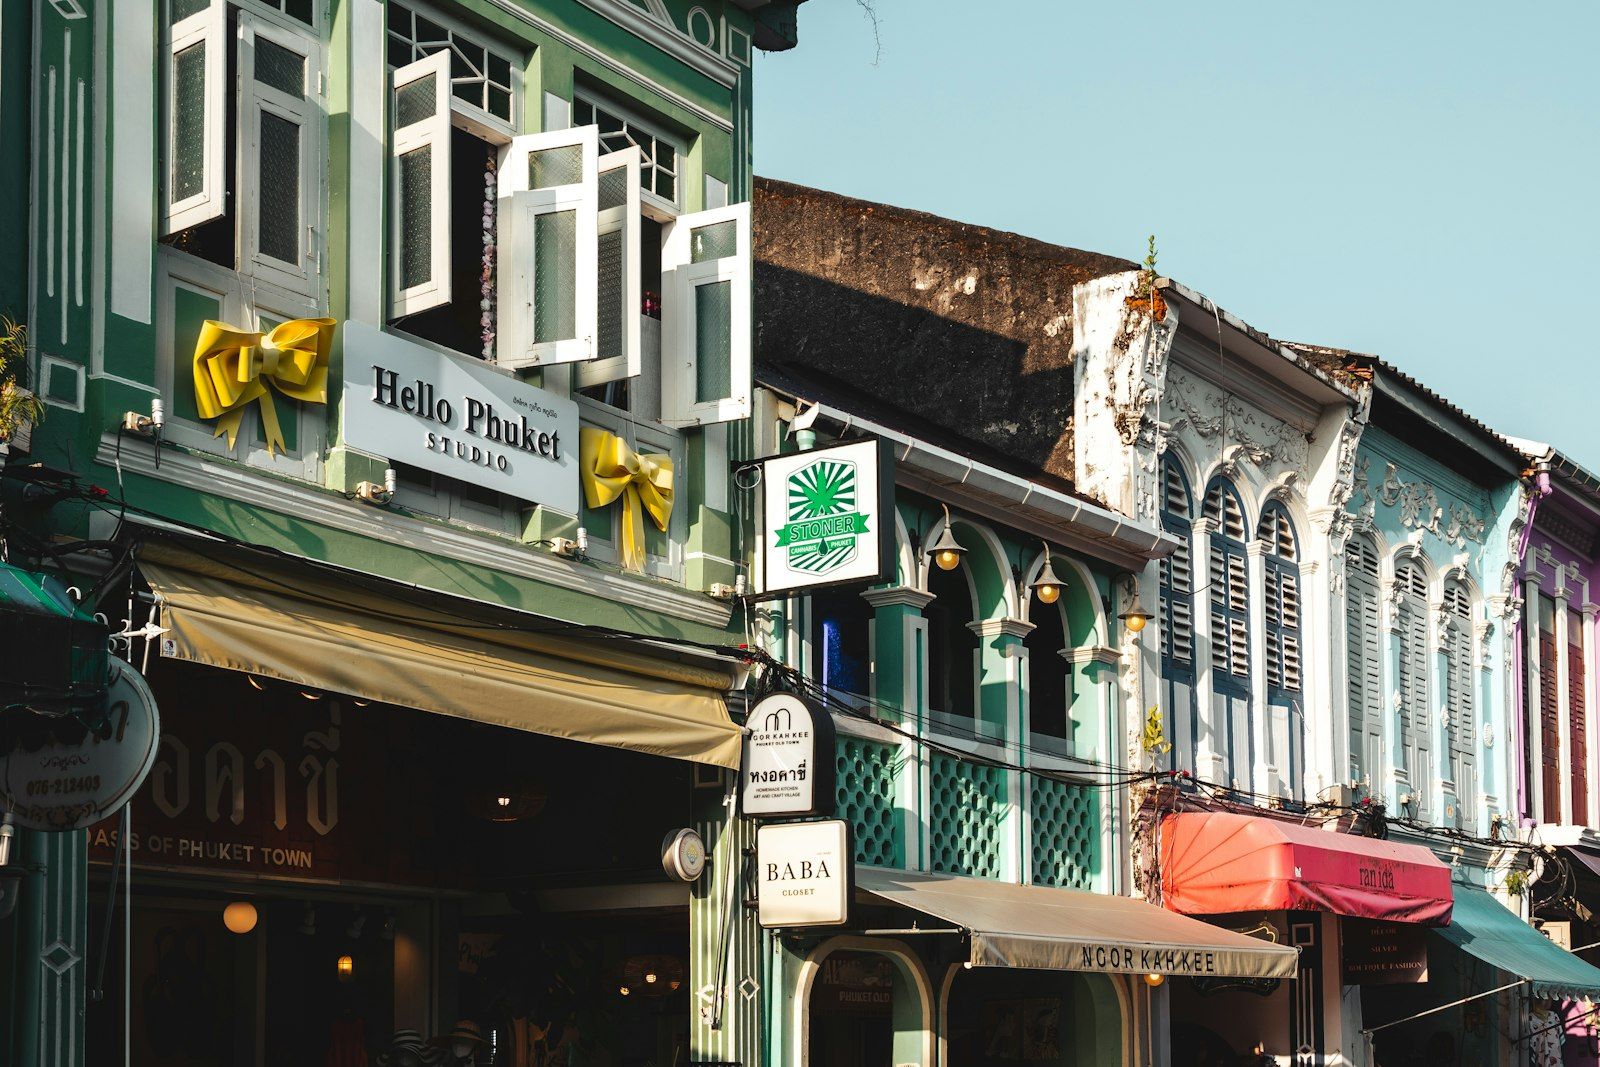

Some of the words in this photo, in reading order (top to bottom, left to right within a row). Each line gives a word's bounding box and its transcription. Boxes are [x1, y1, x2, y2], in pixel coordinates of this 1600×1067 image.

[371, 365, 452, 424] Hello
[463, 396, 561, 460] Phuket
[426, 432, 508, 471] STUDIO
[789, 516, 855, 541] STONER
[790, 544, 817, 555] CANNABIS
[830, 538, 853, 549] PHUKET
[87, 829, 140, 851] ASIS
[148, 834, 174, 854] OF
[179, 838, 255, 863] PHUKET
[261, 847, 313, 869] TOWN
[766, 860, 831, 882] BABA
[782, 888, 815, 897] CLOSET
[1141, 949, 1175, 971] KAH
[1181, 951, 1214, 972] KEE
[1348, 962, 1387, 972] BOUTIQUE
[1389, 961, 1422, 970] FASHION
[839, 990, 872, 1003] PHUKET
